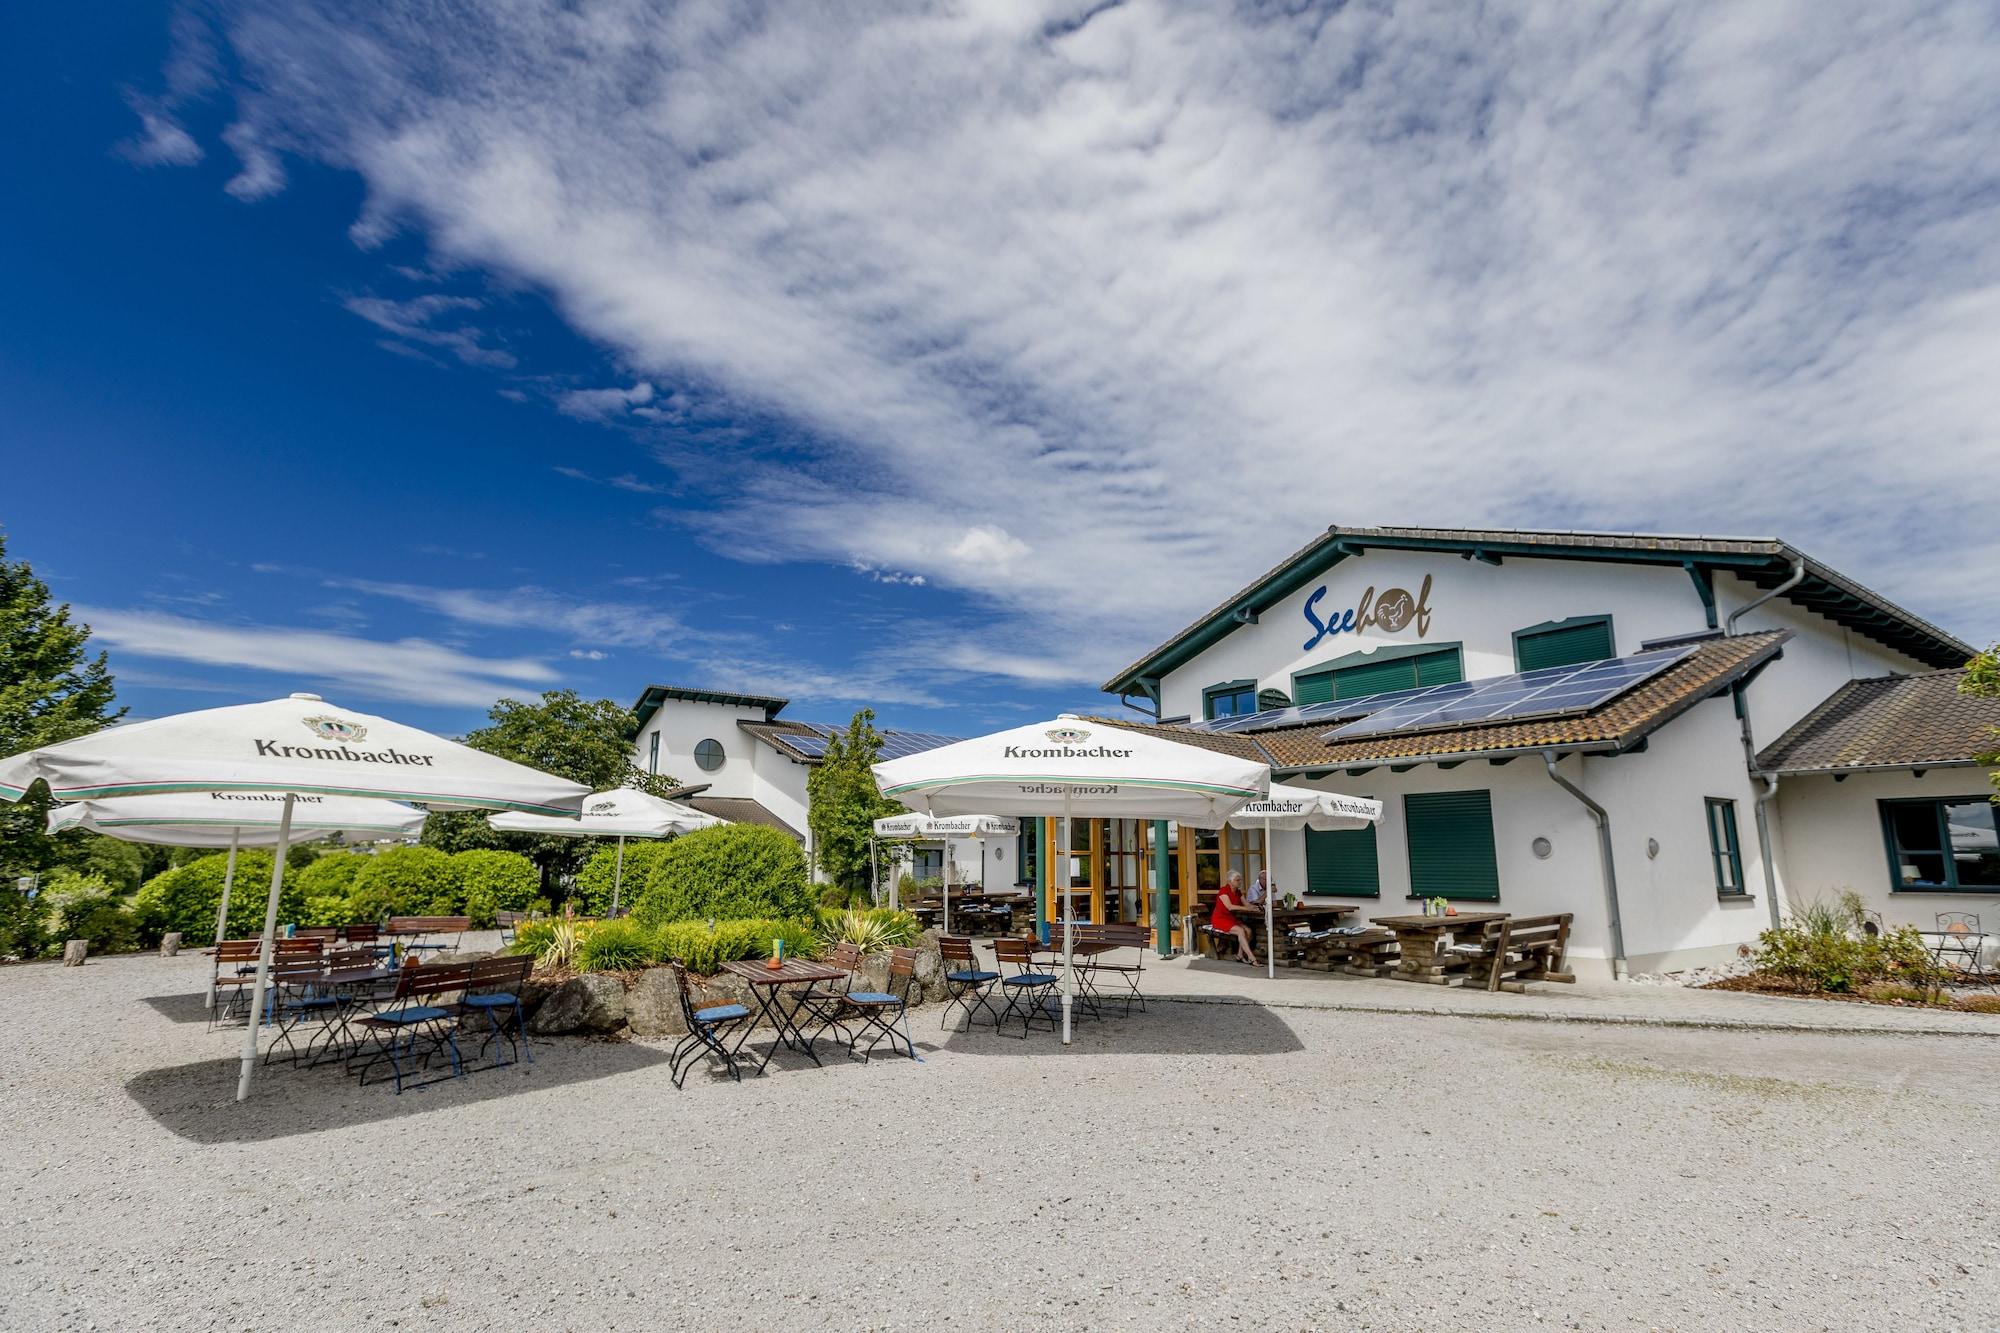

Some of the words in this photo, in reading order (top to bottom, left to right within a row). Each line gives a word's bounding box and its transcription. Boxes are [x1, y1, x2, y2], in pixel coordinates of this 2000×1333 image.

[1303, 573, 1432, 651] Seehof
[254, 739, 434, 766] Krombacher
[1004, 746, 1133, 758] Krombacher
[211, 792, 324, 803] Krombaher
[934, 820, 971, 830] Krombacher
